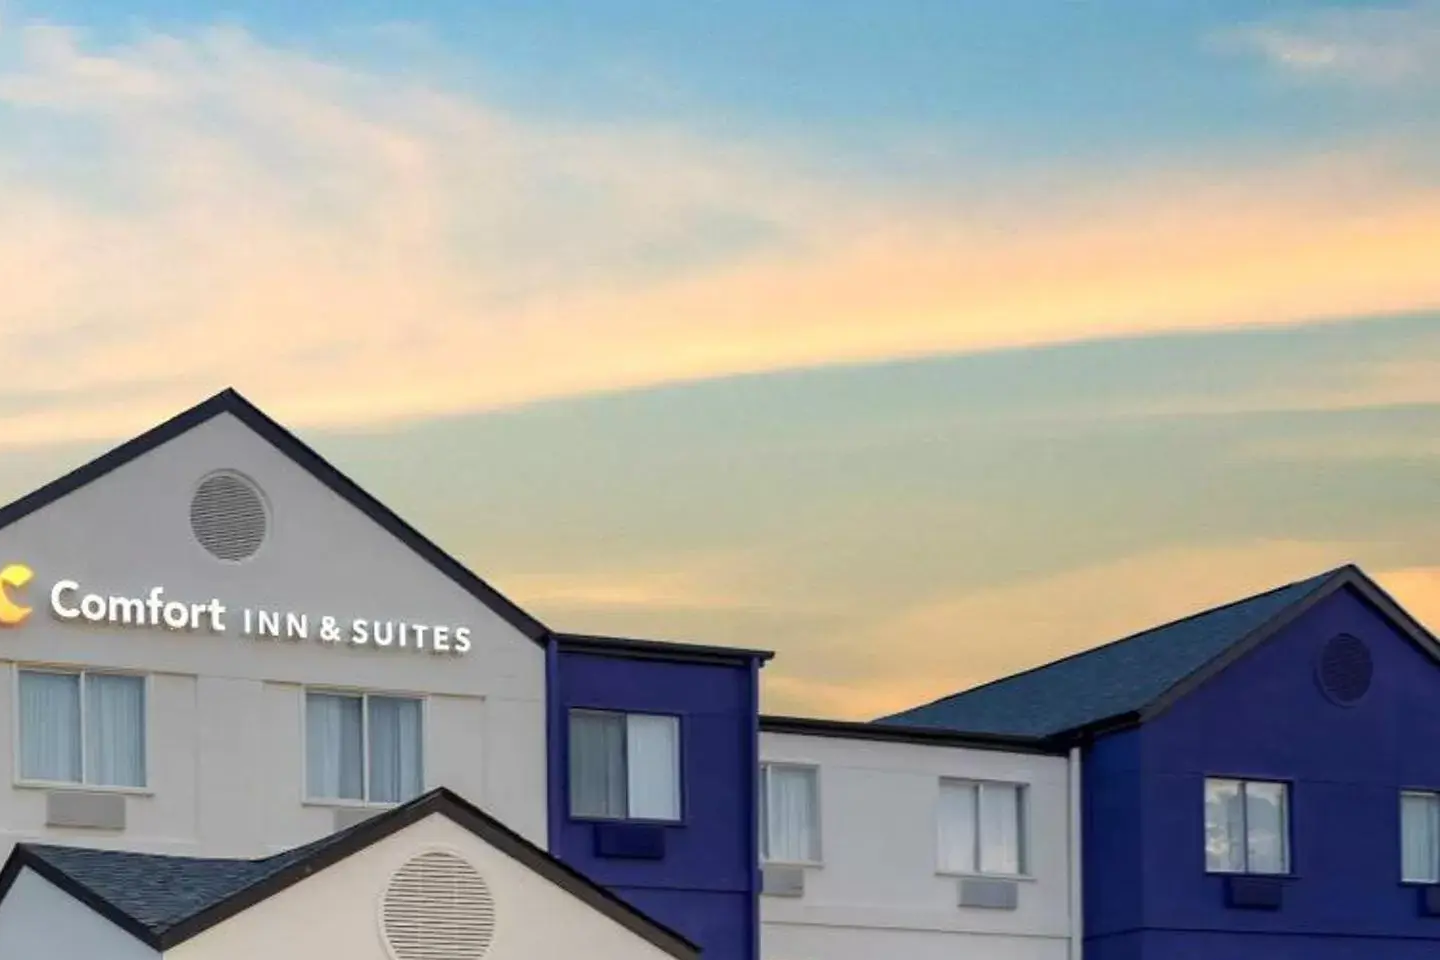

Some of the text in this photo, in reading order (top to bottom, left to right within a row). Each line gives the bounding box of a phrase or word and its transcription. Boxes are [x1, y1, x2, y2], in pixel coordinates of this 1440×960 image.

[50, 579, 227, 631] Comfort
[243, 608, 308, 639] INN
[319, 615, 341, 642] &
[351, 619, 472, 653] SUITES
